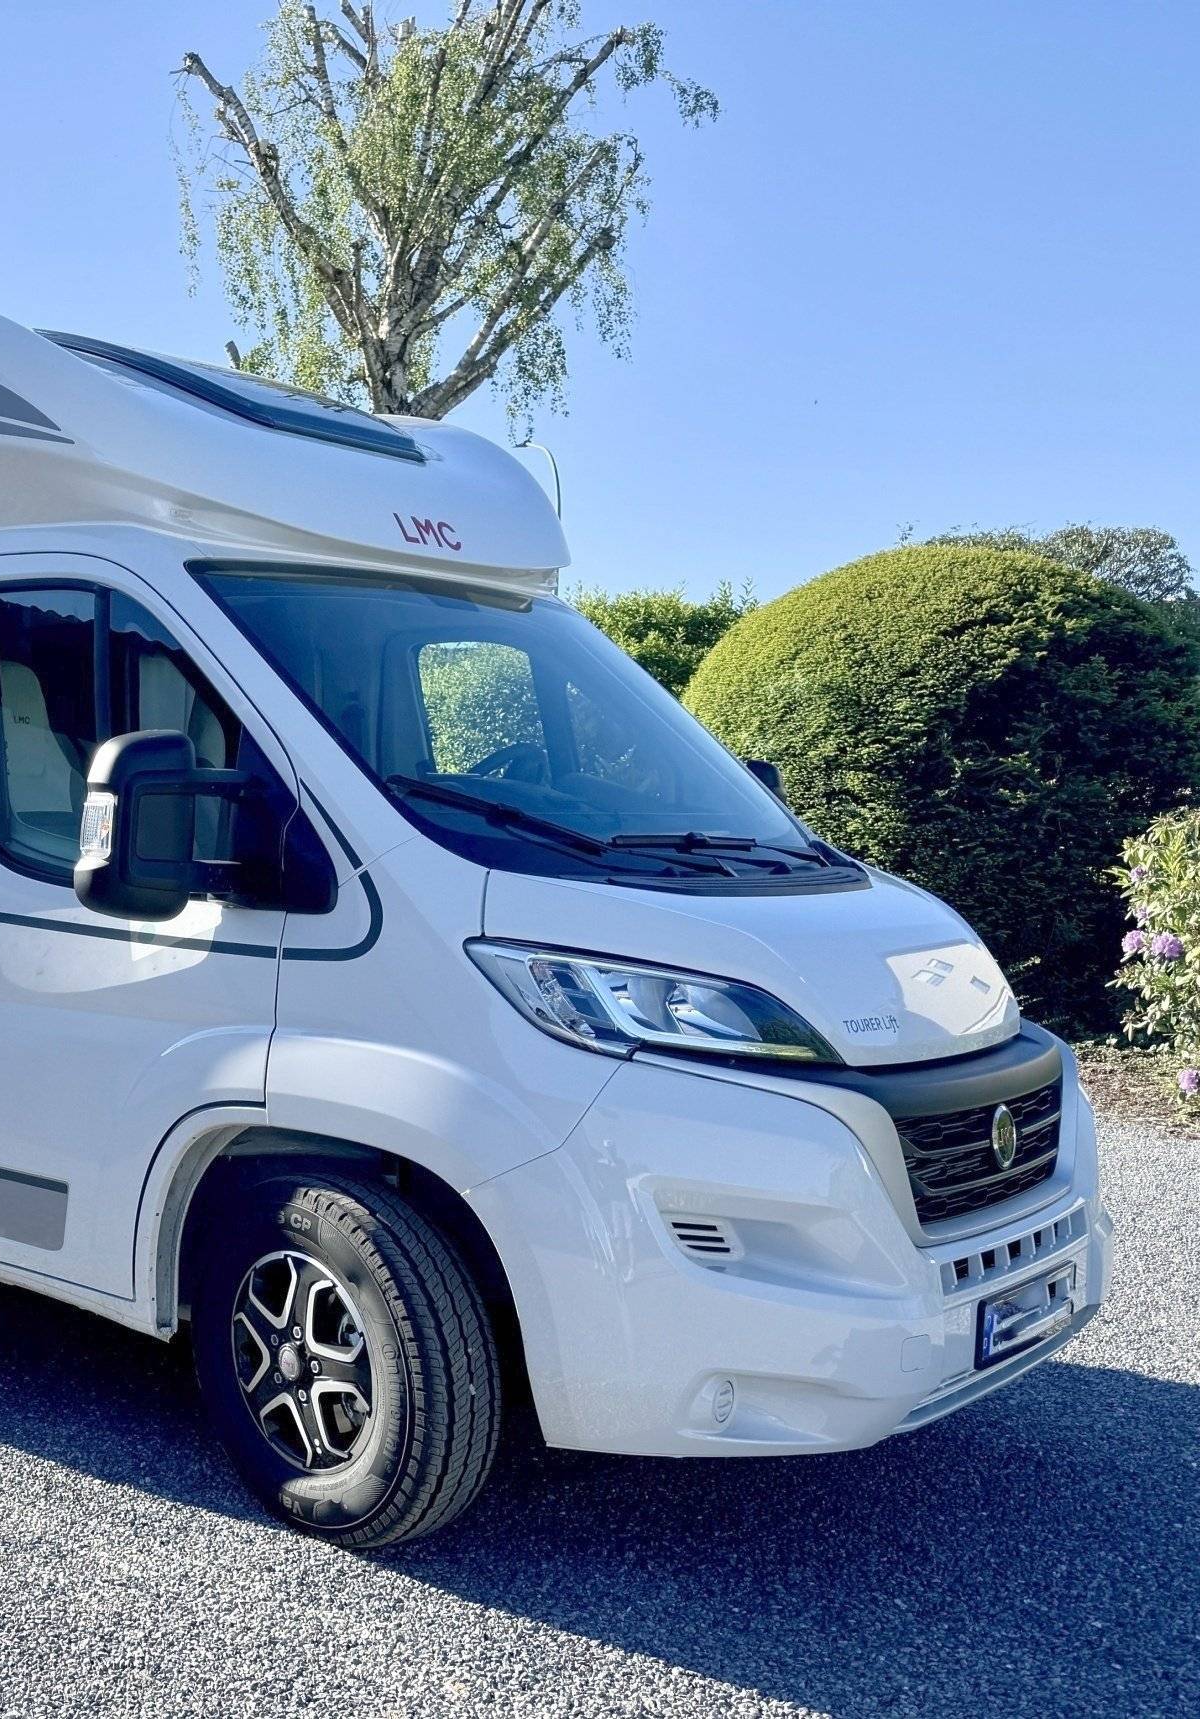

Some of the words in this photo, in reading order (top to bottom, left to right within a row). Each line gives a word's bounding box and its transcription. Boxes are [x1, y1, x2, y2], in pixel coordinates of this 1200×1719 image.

[392, 512, 462, 552] LMC
[13, 715, 31, 725] LMC
[843, 1017, 884, 1034] TOURER
[882, 1014, 900, 1034] Lift
